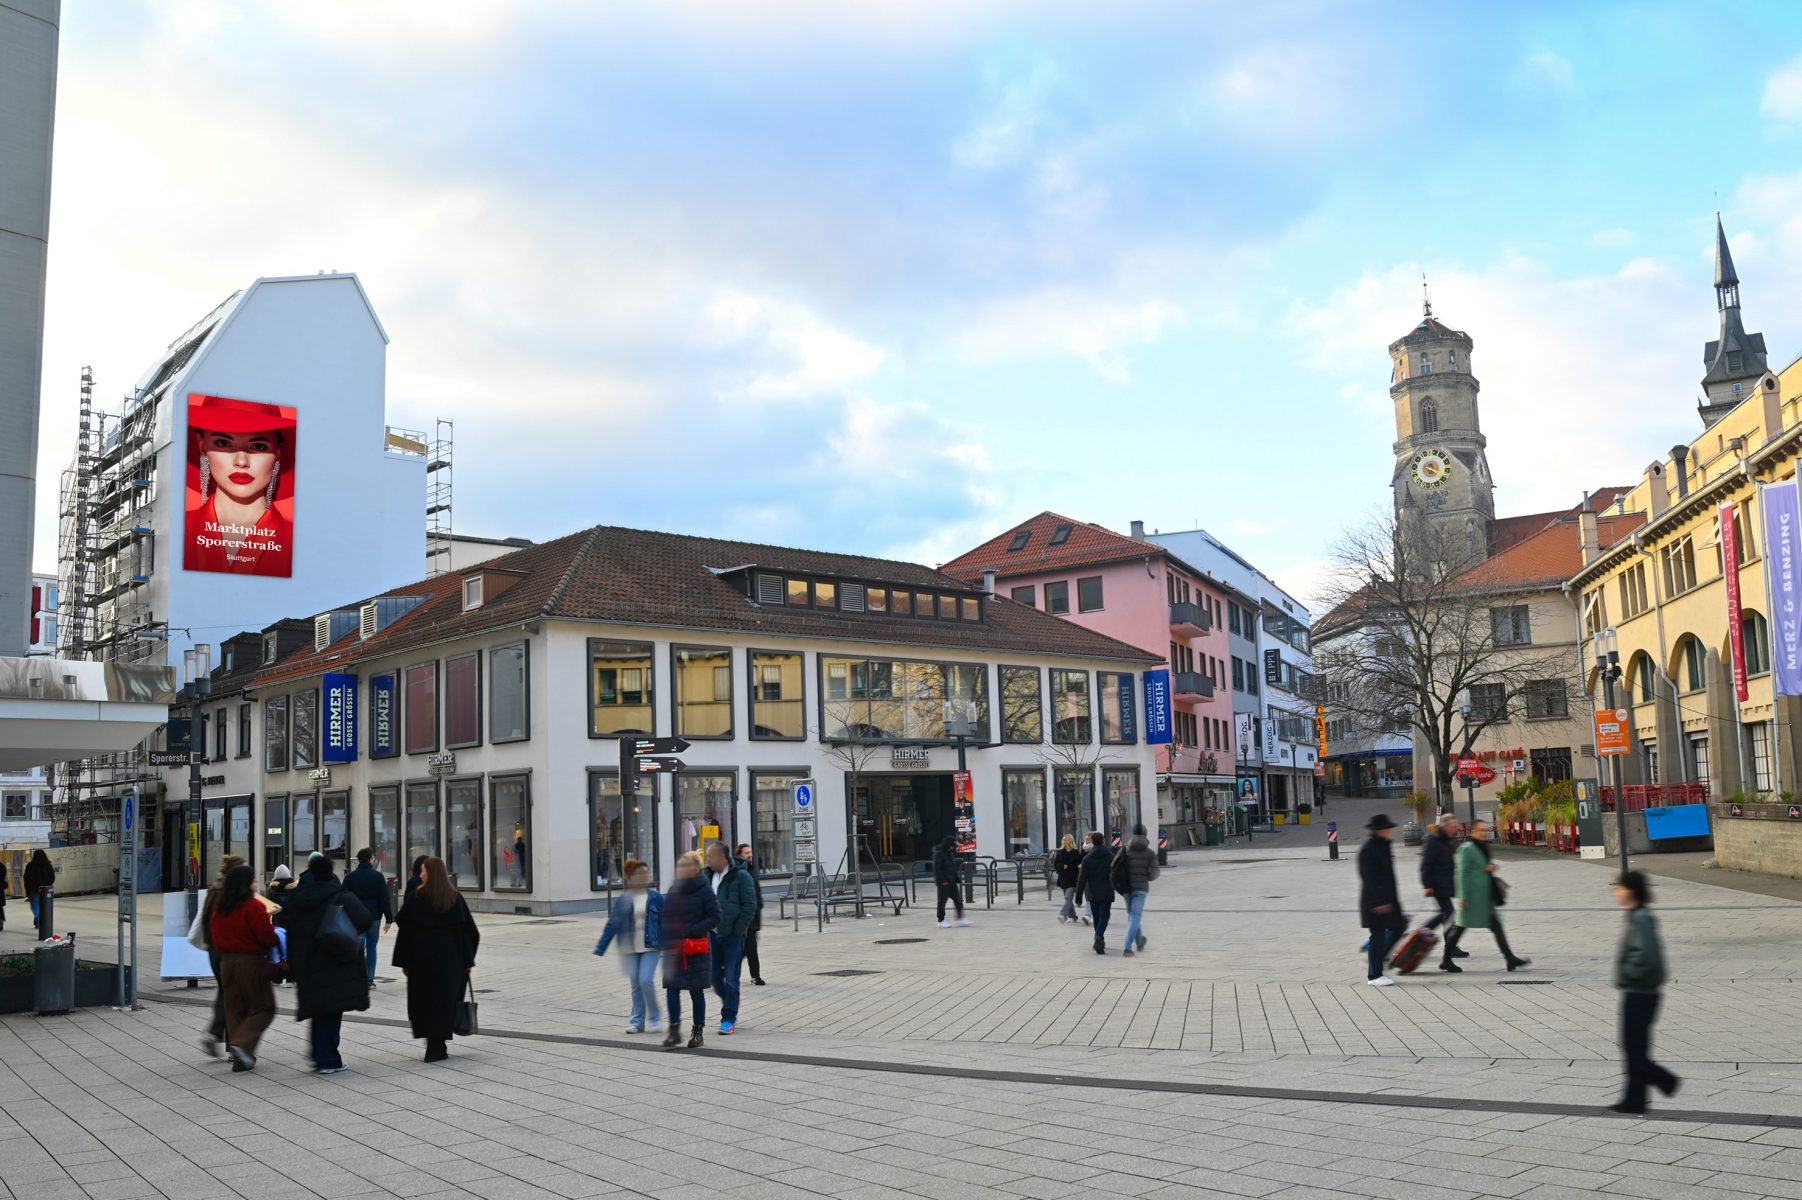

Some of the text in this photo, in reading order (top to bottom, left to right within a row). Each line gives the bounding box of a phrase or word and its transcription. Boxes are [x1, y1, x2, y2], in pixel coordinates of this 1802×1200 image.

[204, 522, 276, 537] Marktplatz
[196, 535, 282, 551] Sporerstraße
[226, 554, 256, 562] Stuttgart
[1780, 513, 1797, 670] MERZ & BENZING
[1267, 650, 1277, 673] EPPLI
[345, 688, 353, 718] GRÖSSEN
[1155, 682, 1165, 732] HIRMER
[330, 688, 342, 747] HIRMER
[1266, 726, 1274, 755] HERZOG
[151, 754, 189, 764] Sporerstr.
[427, 752, 453, 765] HIRMER
[894, 749, 930, 759] HIRMER
[1498, 747, 1524, 760] CAFÉ
[308, 768, 329, 779] HIRMER
